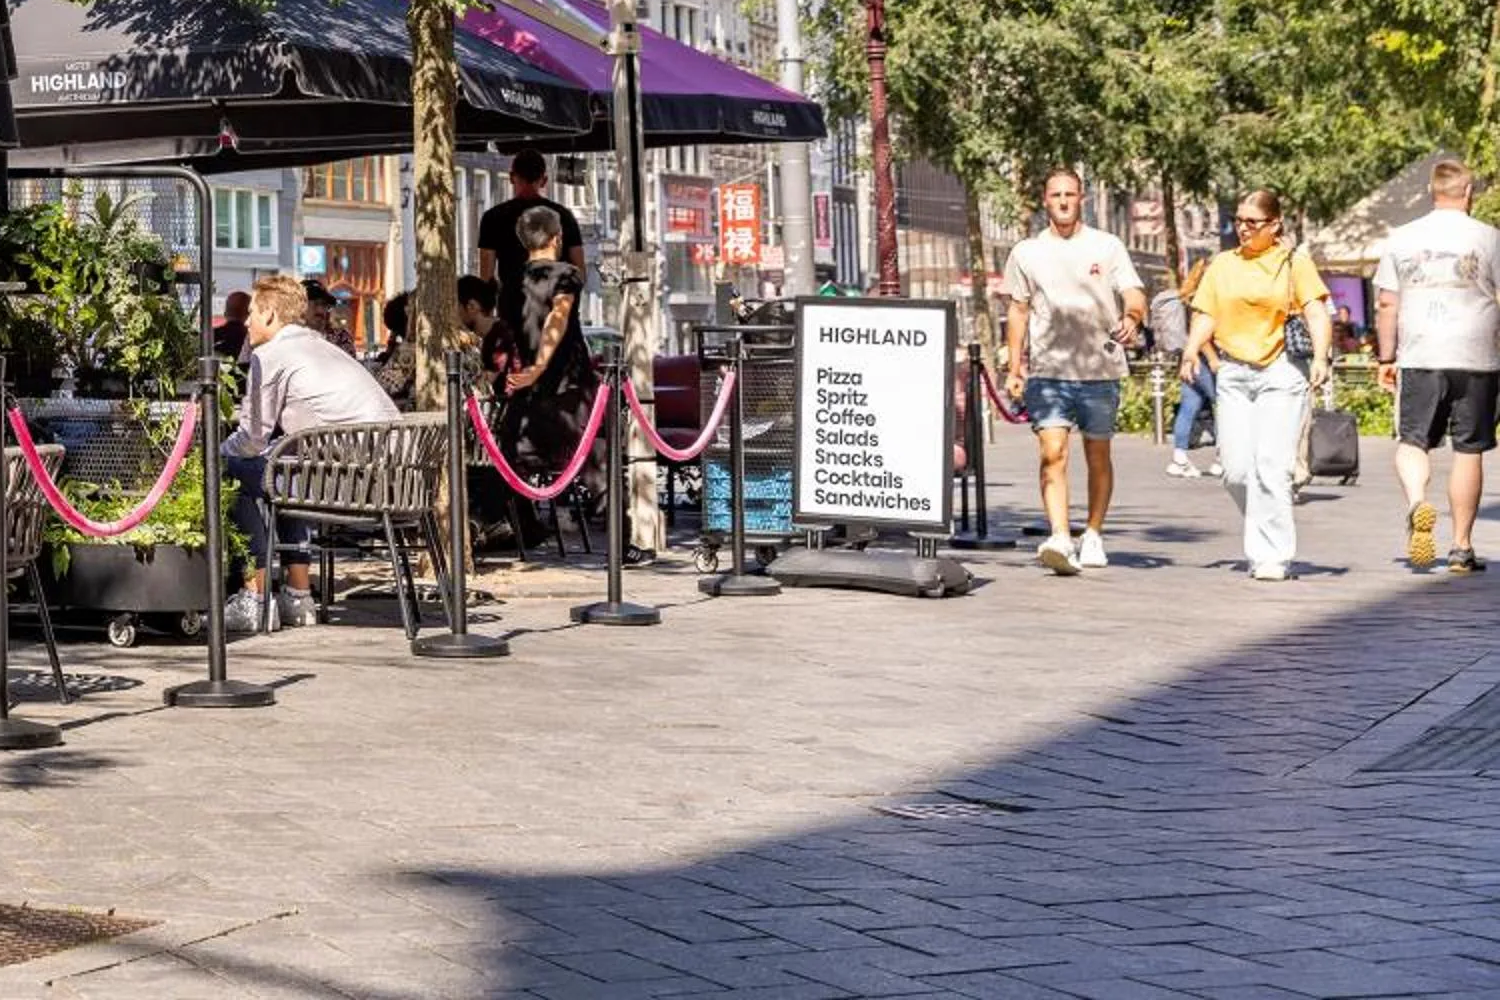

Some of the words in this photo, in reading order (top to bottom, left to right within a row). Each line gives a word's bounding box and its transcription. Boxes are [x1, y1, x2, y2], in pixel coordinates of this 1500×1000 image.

[31, 71, 127, 93] HIGHLAND
[819, 327, 927, 347] HIGHLAND
[816, 367, 863, 385] Pizza
[816, 388, 868, 410] Spritz
[815, 408, 877, 427] Coffee
[815, 428, 879, 447] Salads
[815, 449, 884, 468] Snacks
[814, 469, 904, 489] Cocktails
[814, 489, 931, 511] Sandwiches
